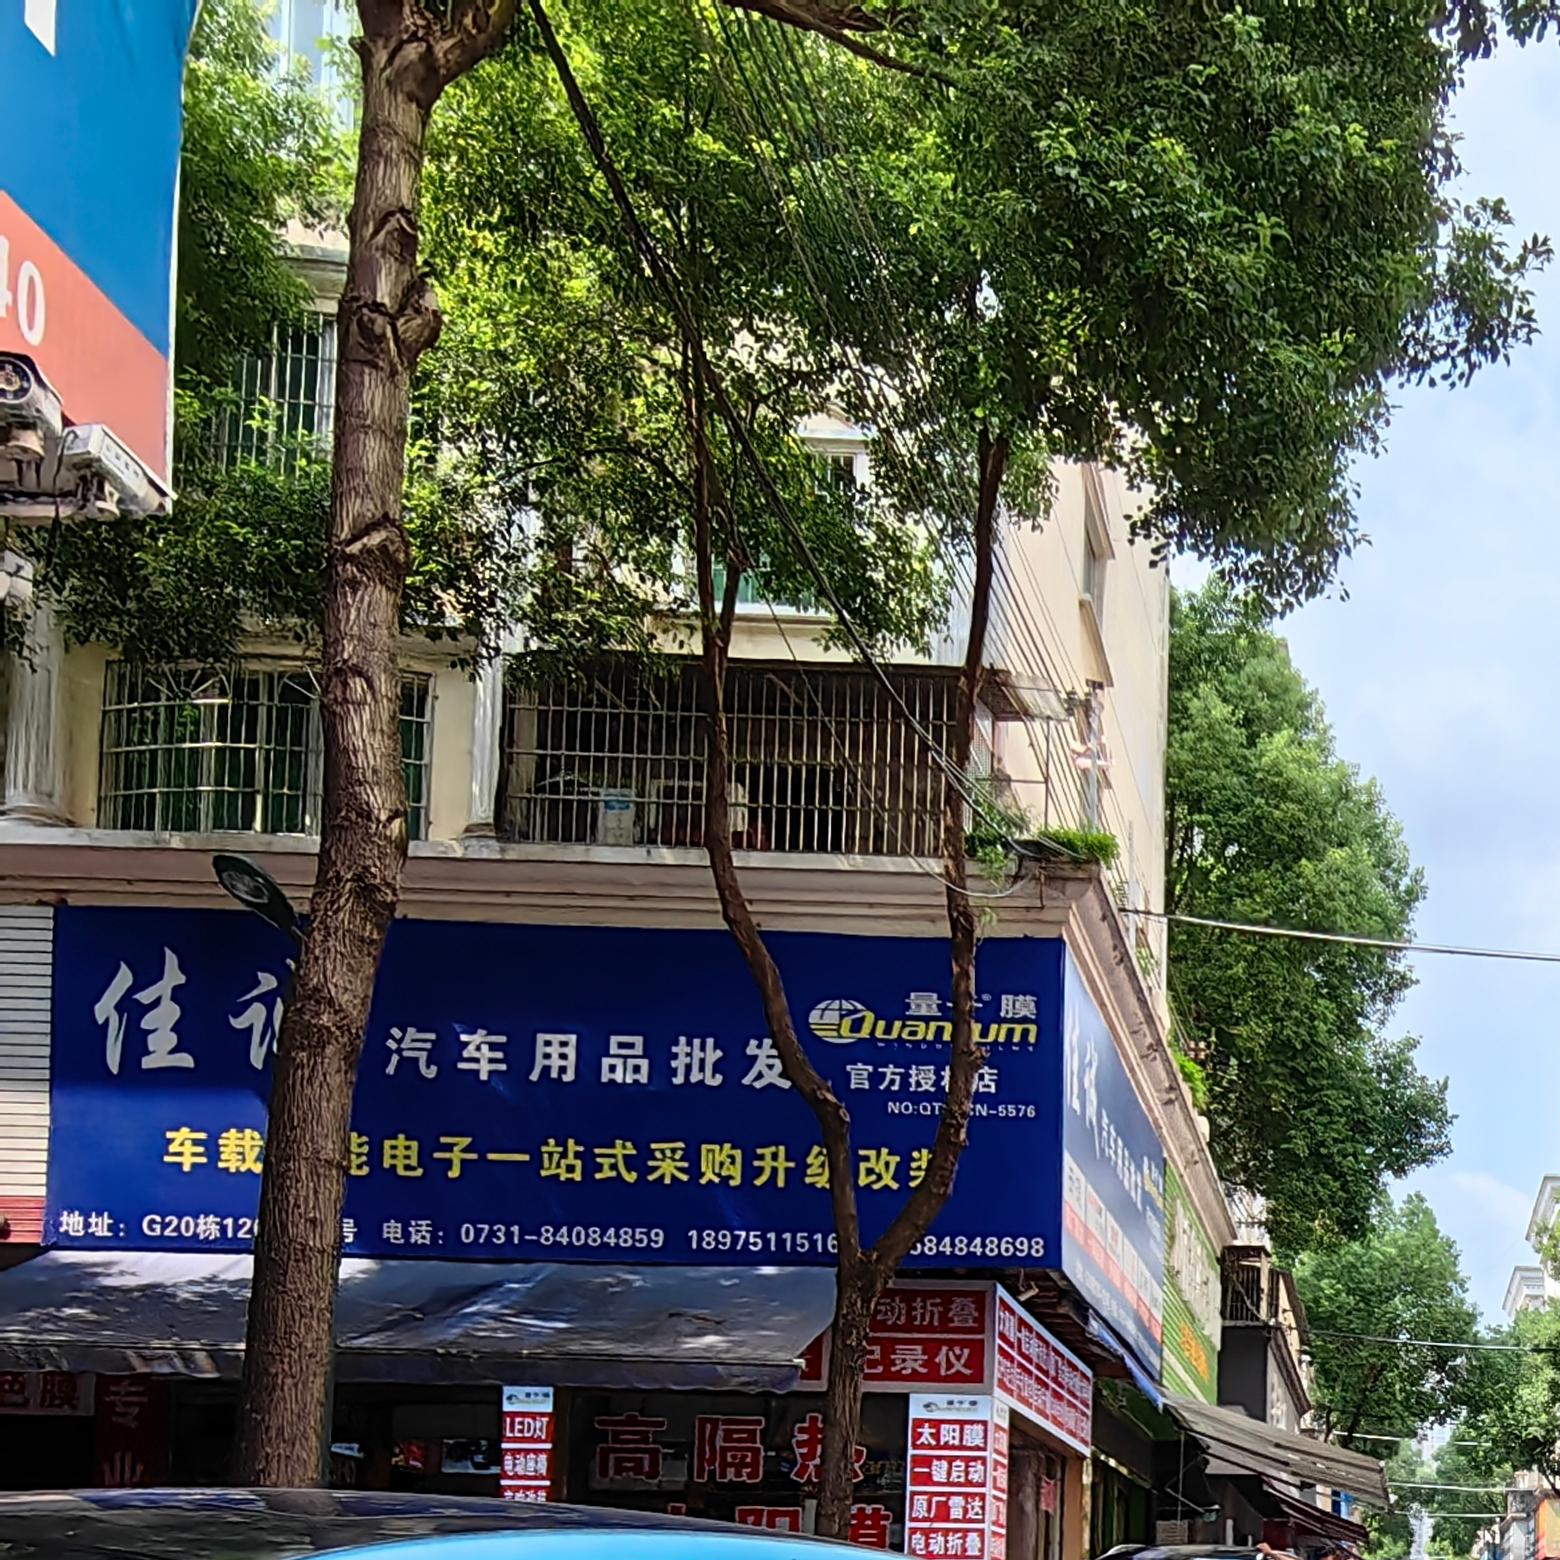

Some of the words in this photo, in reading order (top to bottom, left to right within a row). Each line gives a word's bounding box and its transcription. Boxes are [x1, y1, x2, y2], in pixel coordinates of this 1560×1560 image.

[905, 992, 1037, 1019] 量膜
[838, 1011, 1038, 1044] Quanum
[384, 1026, 793, 1090] 汽车用品批发
[687, 1229, 838, 1254] 1897511516
[908, 1235, 1045, 1258] 84848698
[876, 1296, 979, 1328] 动折叠
[505, 1417, 549, 1440] LED灯
[916, 1423, 986, 1447] 太阳膜
[594, 1411, 866, 1484] 高隔热
[913, 1459, 986, 1483] 一键启动
[911, 1495, 984, 1520] 原厂雷达
[911, 1532, 982, 1556] 电动折叠
